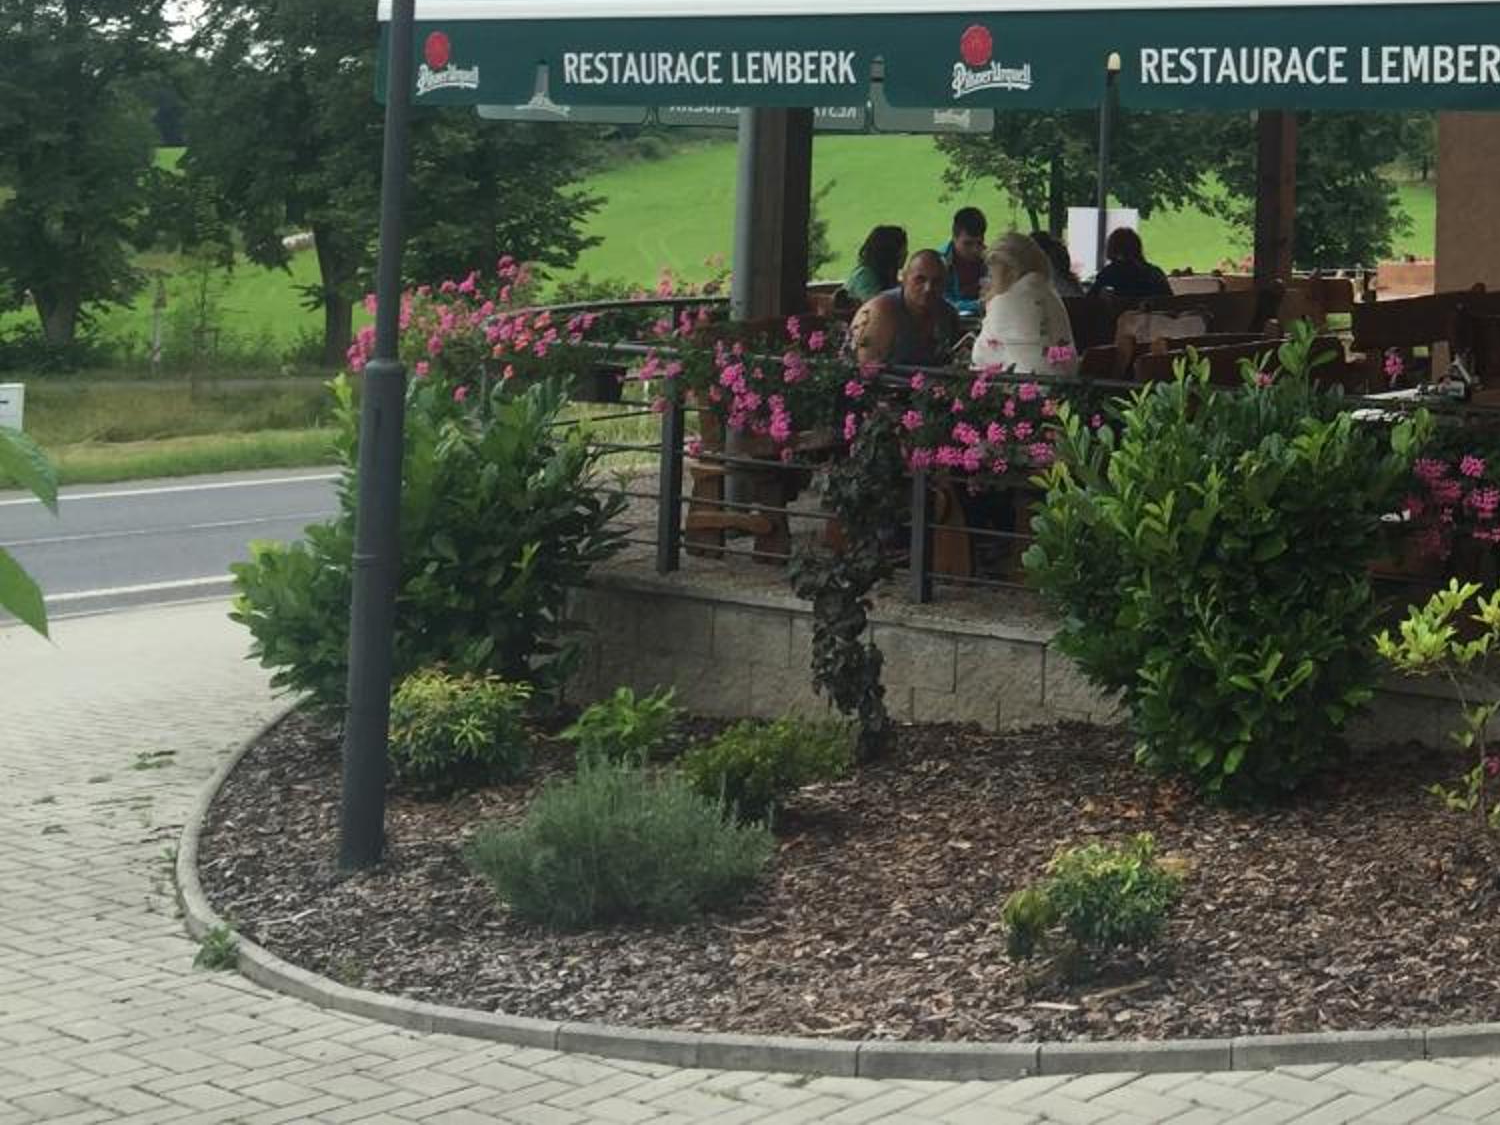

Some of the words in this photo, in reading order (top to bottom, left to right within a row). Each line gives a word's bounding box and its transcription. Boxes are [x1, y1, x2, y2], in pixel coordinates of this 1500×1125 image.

[563, 51, 722, 84] RESTAURACE
[731, 50, 857, 84] LEMBERK
[1140, 46, 1348, 84] RESTAURACE
